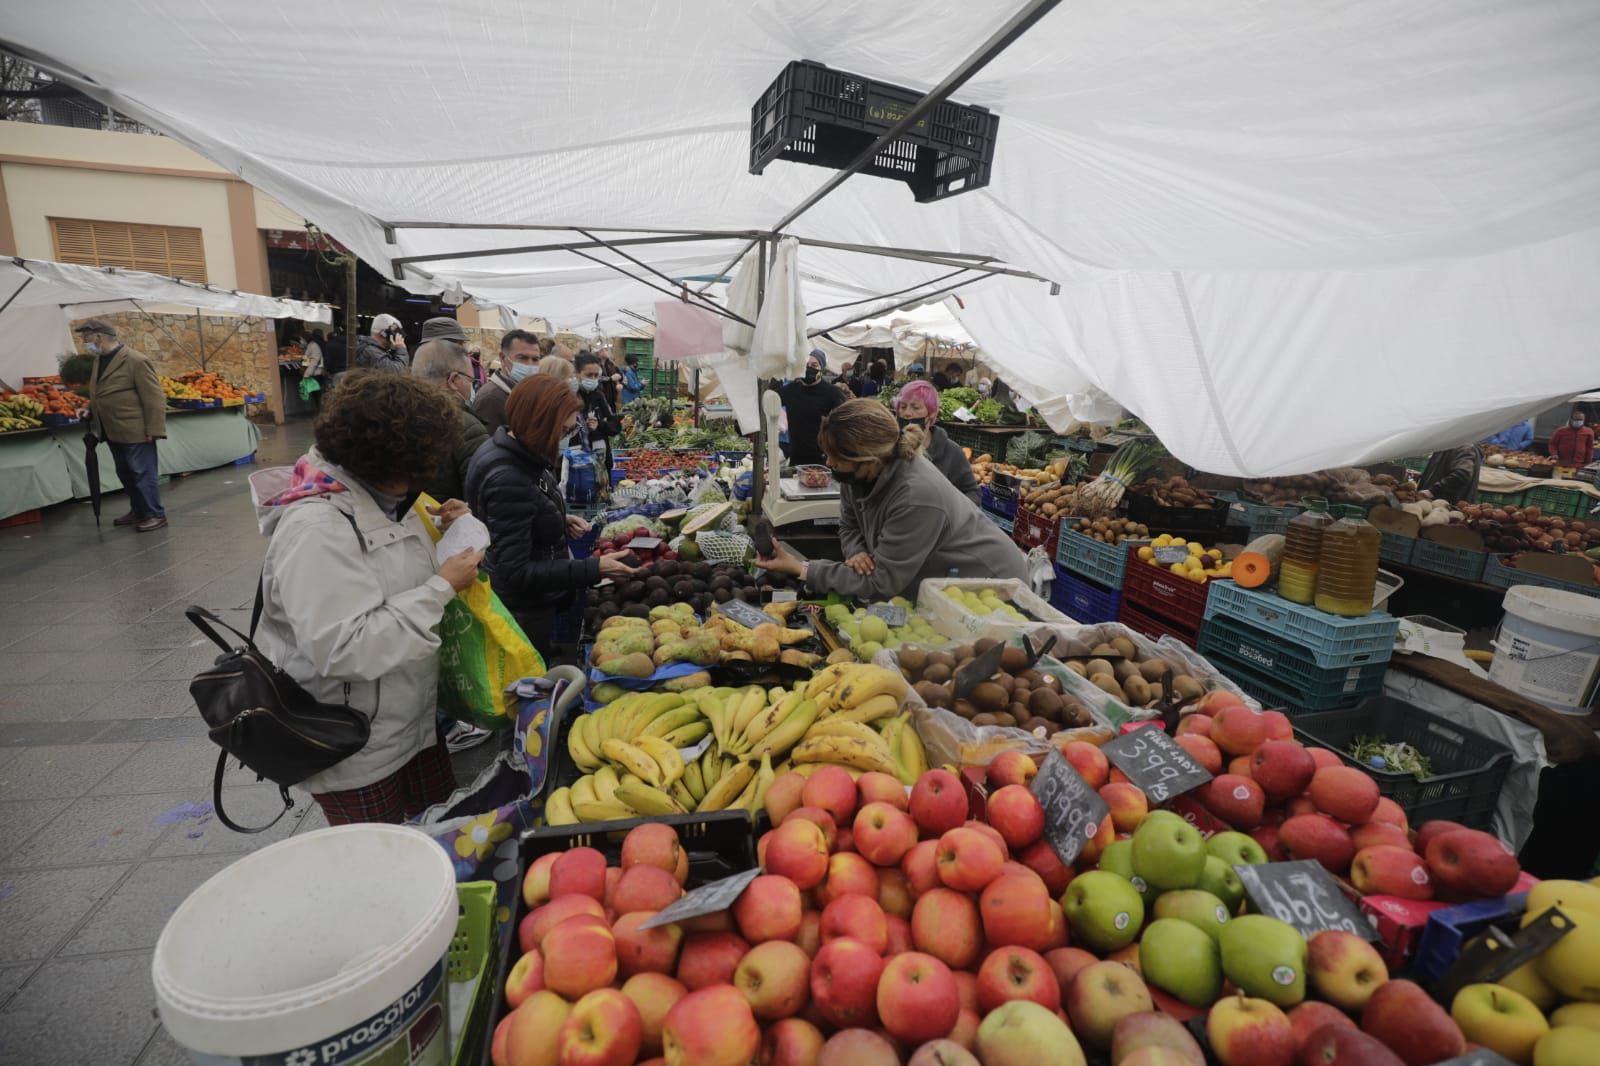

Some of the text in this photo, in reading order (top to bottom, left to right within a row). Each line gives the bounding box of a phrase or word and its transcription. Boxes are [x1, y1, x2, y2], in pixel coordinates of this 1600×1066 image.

[1144, 730, 1201, 774] PINK LADY
[321, 981, 424, 1063] procolor
